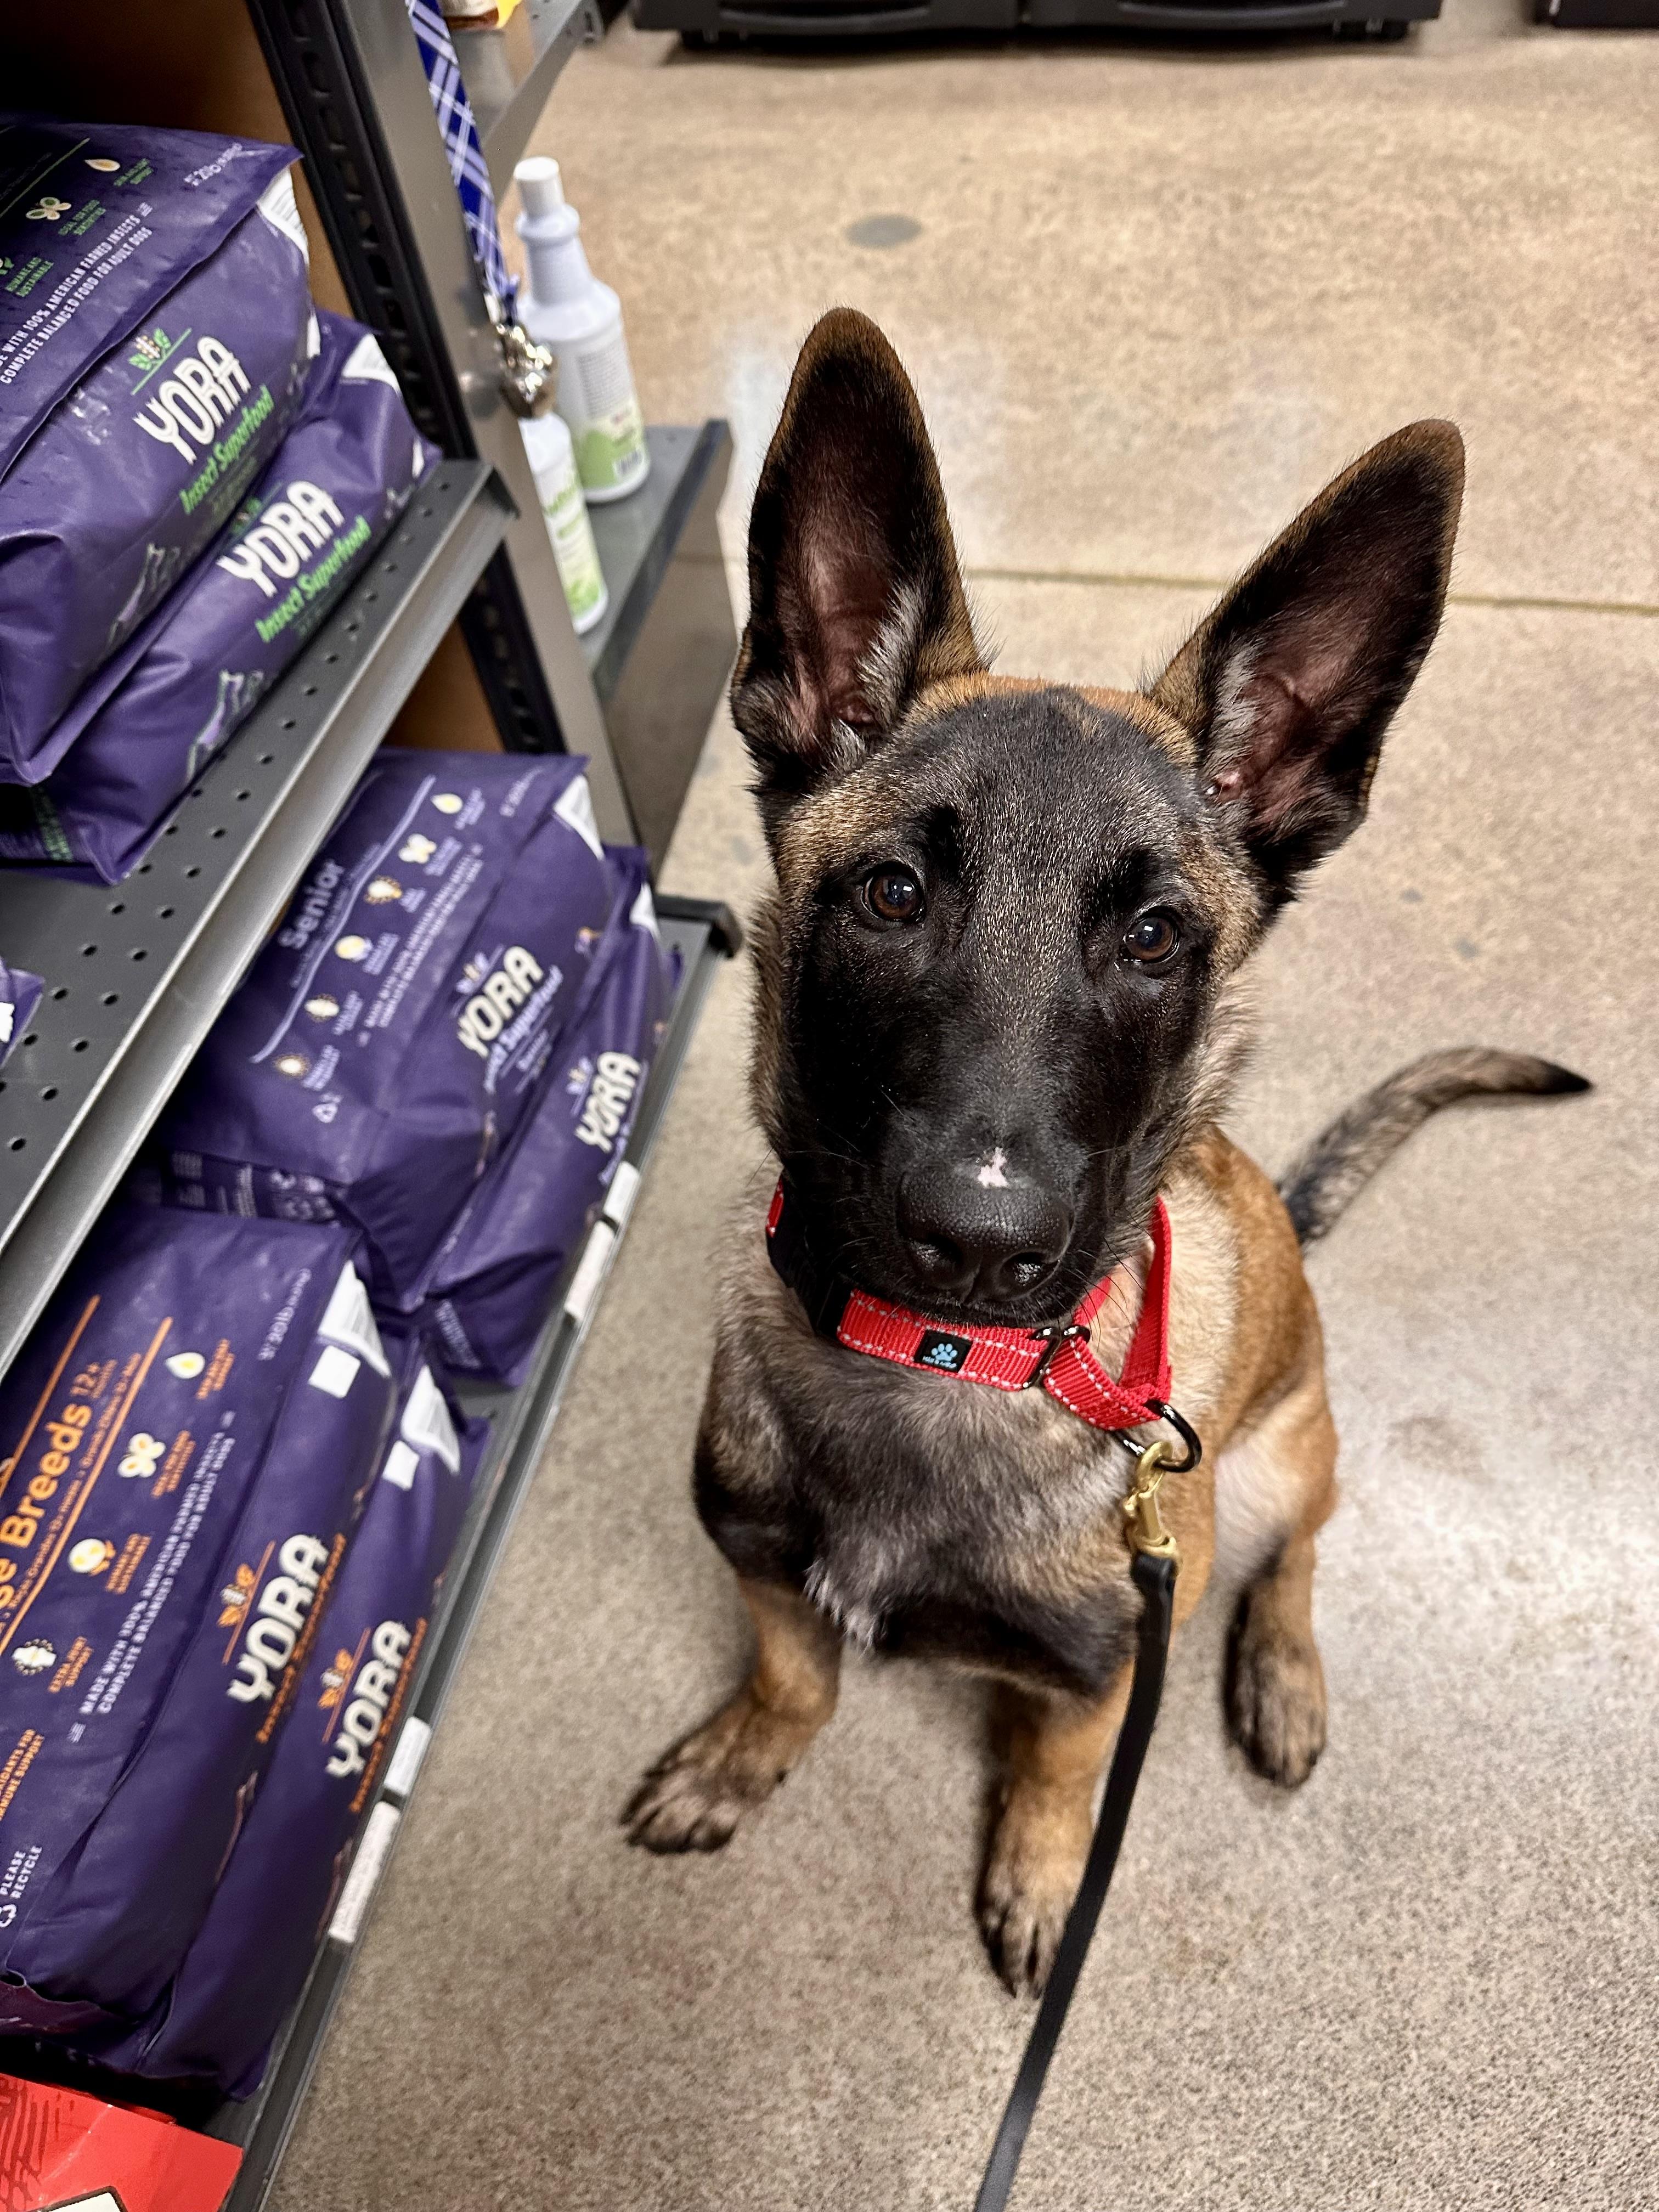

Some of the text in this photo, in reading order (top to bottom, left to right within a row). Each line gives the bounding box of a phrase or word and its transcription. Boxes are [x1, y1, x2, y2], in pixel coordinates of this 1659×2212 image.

[1, 338, 43, 385] COMPLETE
[37, 298, 80, 340] BALANCED
[74, 277, 99, 301] FOOD
[93, 259, 111, 279] FOR
[2, 330, 29, 352] WITH
[22, 309, 50, 331] 100%
[46, 263, 86, 311] AMERICAN
[133, 336, 251, 465] YORA
[216, 481, 345, 599] YORA
[279, 857, 346, 949] Senior
[456, 946, 544, 1058] YORA
[575, 1051, 643, 1152] YORA
[0, 1403, 92, 1549] Breeds
[227, 1534, 329, 1701] YORA
[78, 1675, 110, 1715] MADE
[100, 1639, 129, 1674] WITH
[97, 1645, 143, 1714] COMPLETE
[325, 1620, 411, 1778] YORA
[0, 1851, 26, 1895] PLEASE
[10, 1845, 42, 1899] RECYCLE
